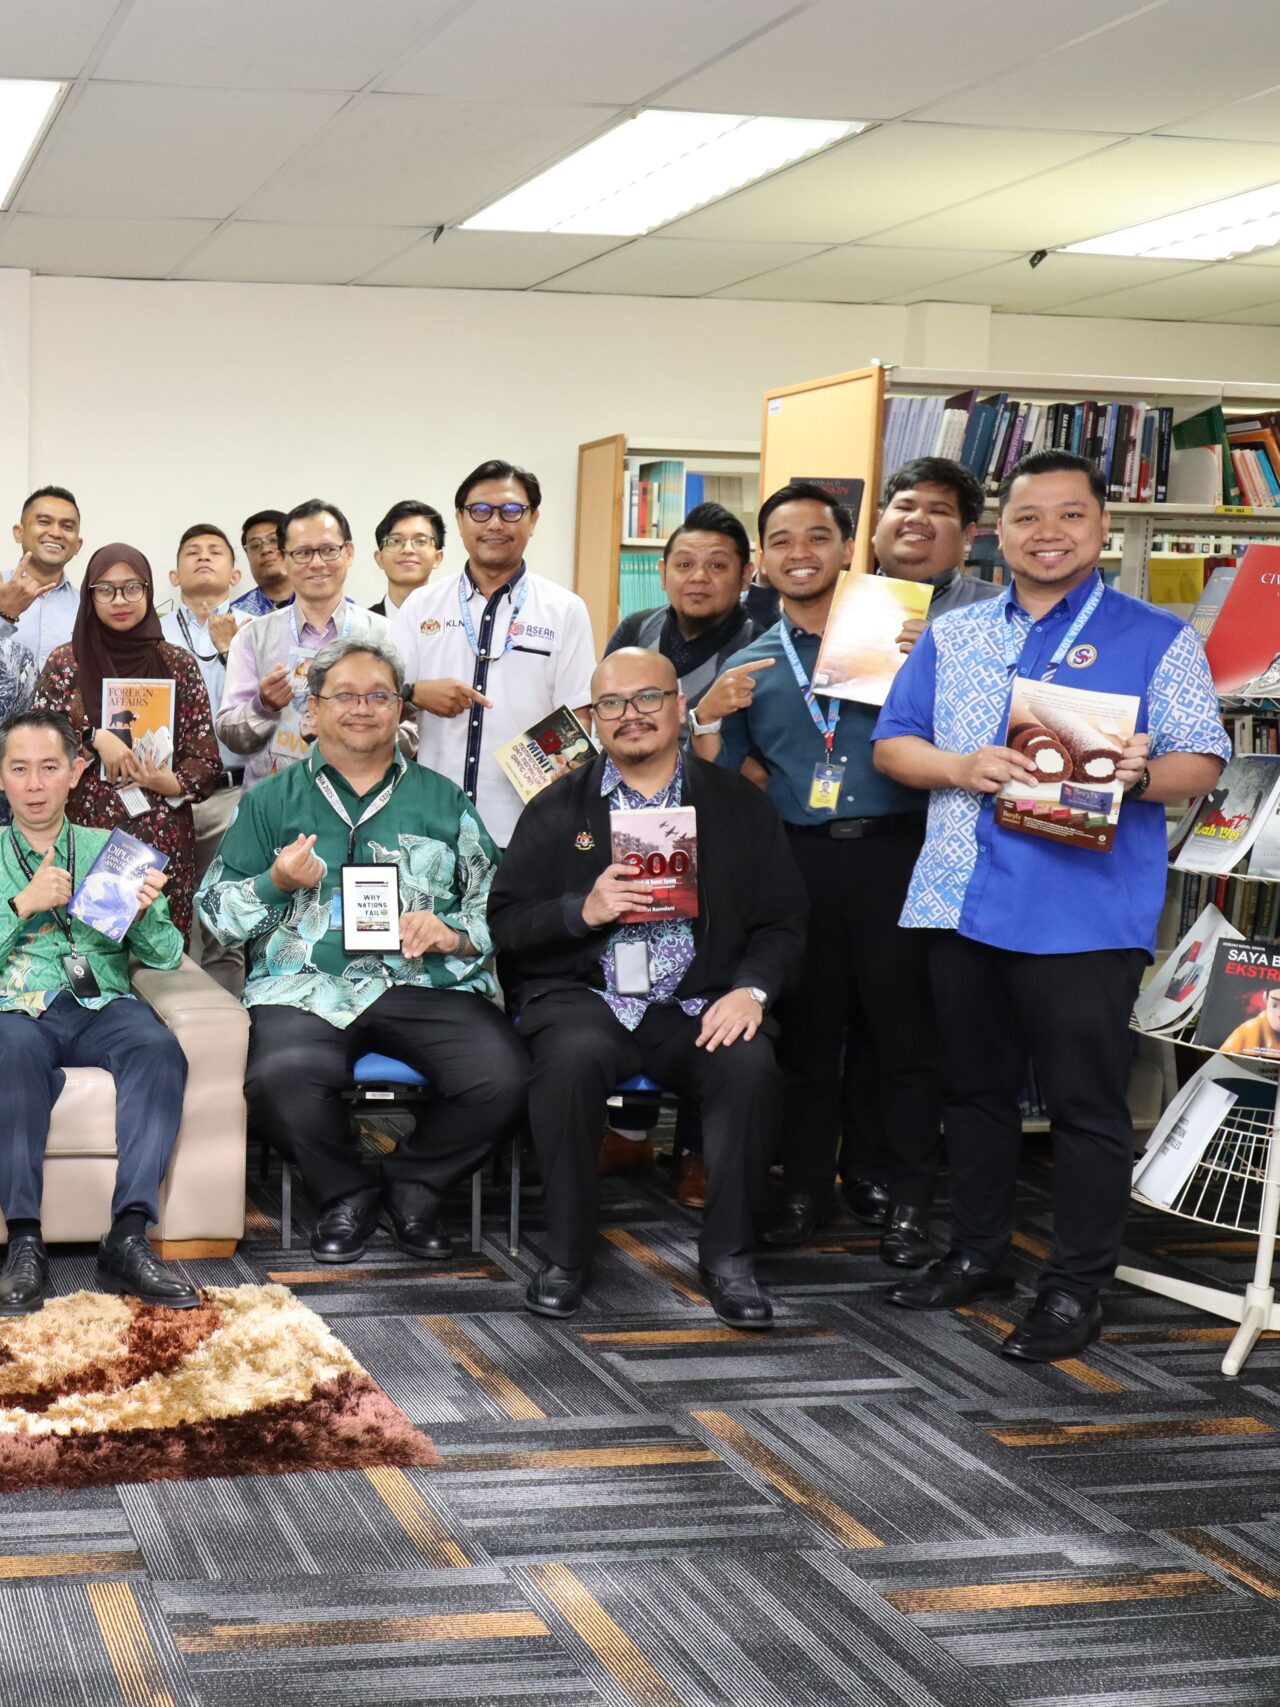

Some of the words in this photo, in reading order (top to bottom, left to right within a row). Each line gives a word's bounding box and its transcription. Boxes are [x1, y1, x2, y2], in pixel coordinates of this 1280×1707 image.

[526, 625, 555, 638] ASEAN
[109, 687, 154, 698] FOREIGN
[108, 698, 150, 707] AFFAIRS
[527, 739, 554, 774] MINIT
[323, 784, 334, 798] 2025
[1194, 822, 1218, 837] Lah
[623, 849, 690, 879] 300
[1228, 949, 1269, 966] SAYA
[1271, 955, 1280, 967] B
